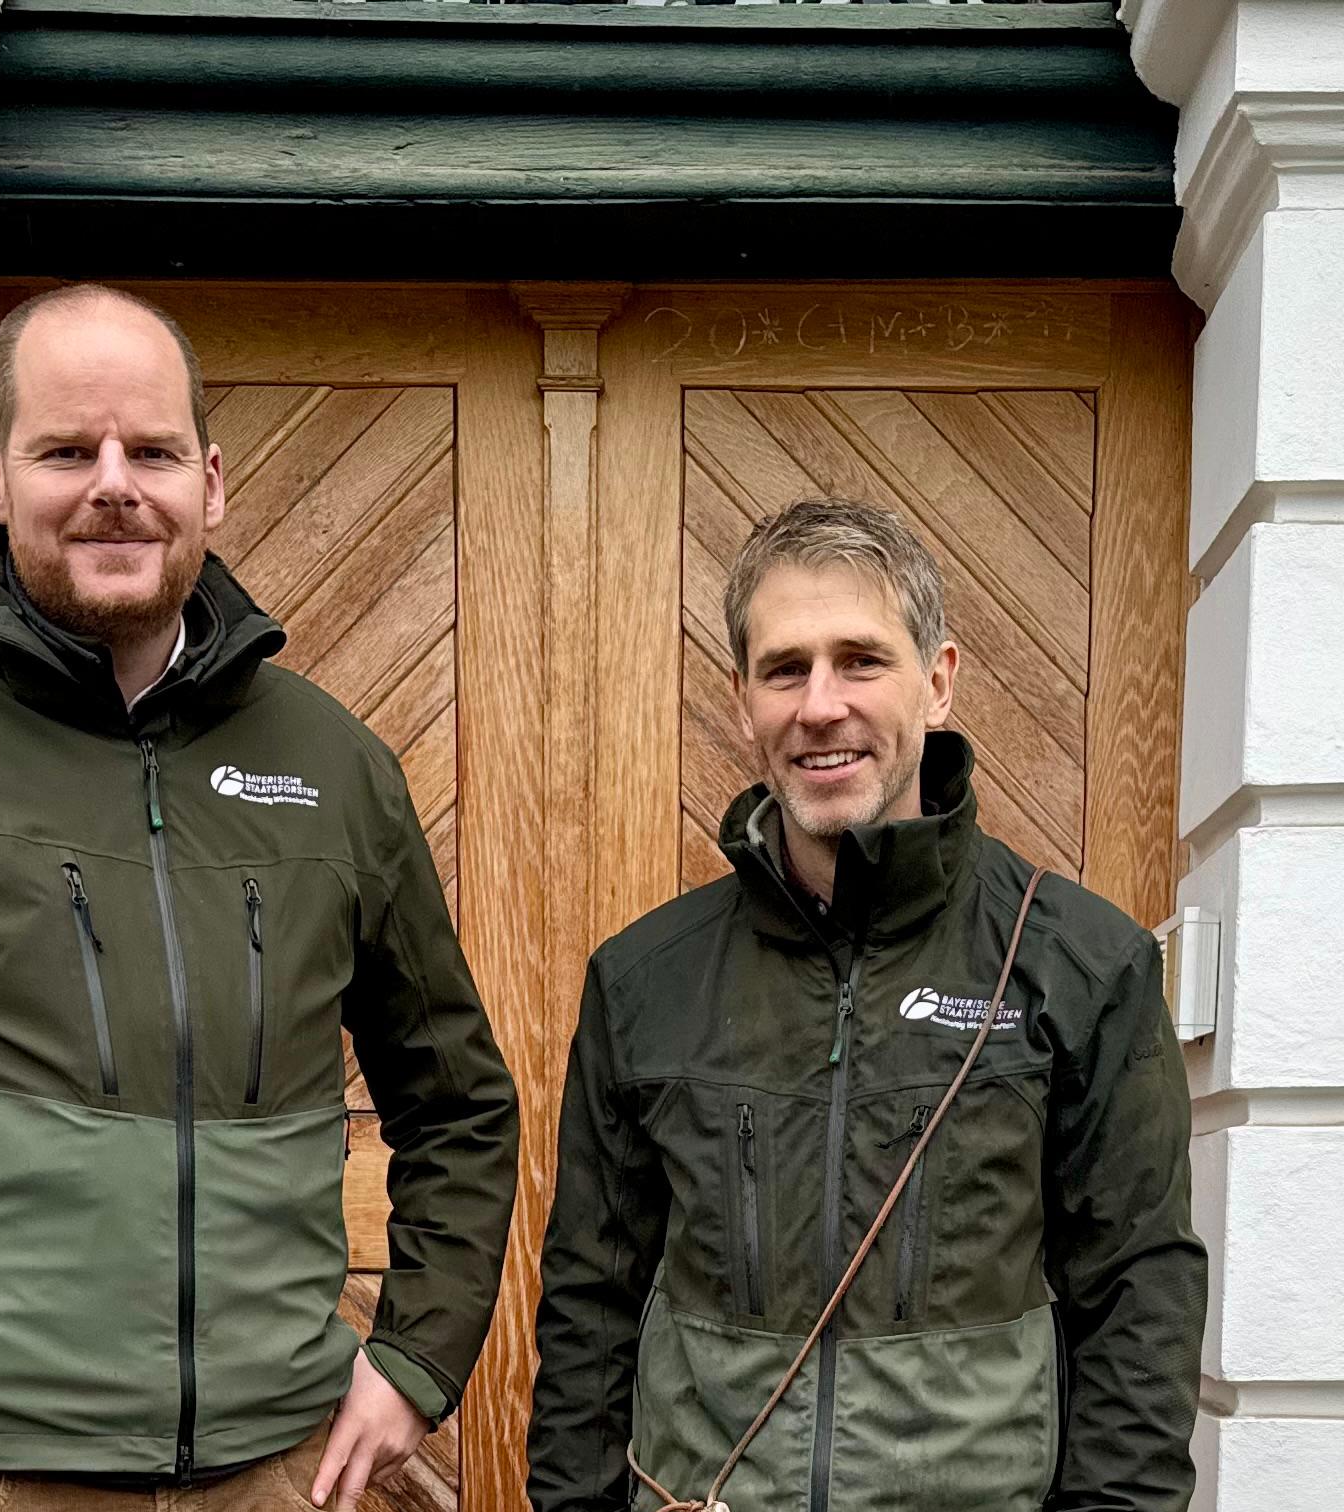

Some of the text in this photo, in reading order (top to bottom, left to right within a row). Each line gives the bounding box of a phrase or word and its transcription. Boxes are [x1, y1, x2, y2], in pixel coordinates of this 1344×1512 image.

[245, 773, 303, 786] BAYERISCHE
[245, 782, 319, 798] STAATSFORSTEN
[942, 995, 1006, 1010] BAYERISCE
[939, 1005, 1023, 1020] STAATSFOSTEN
